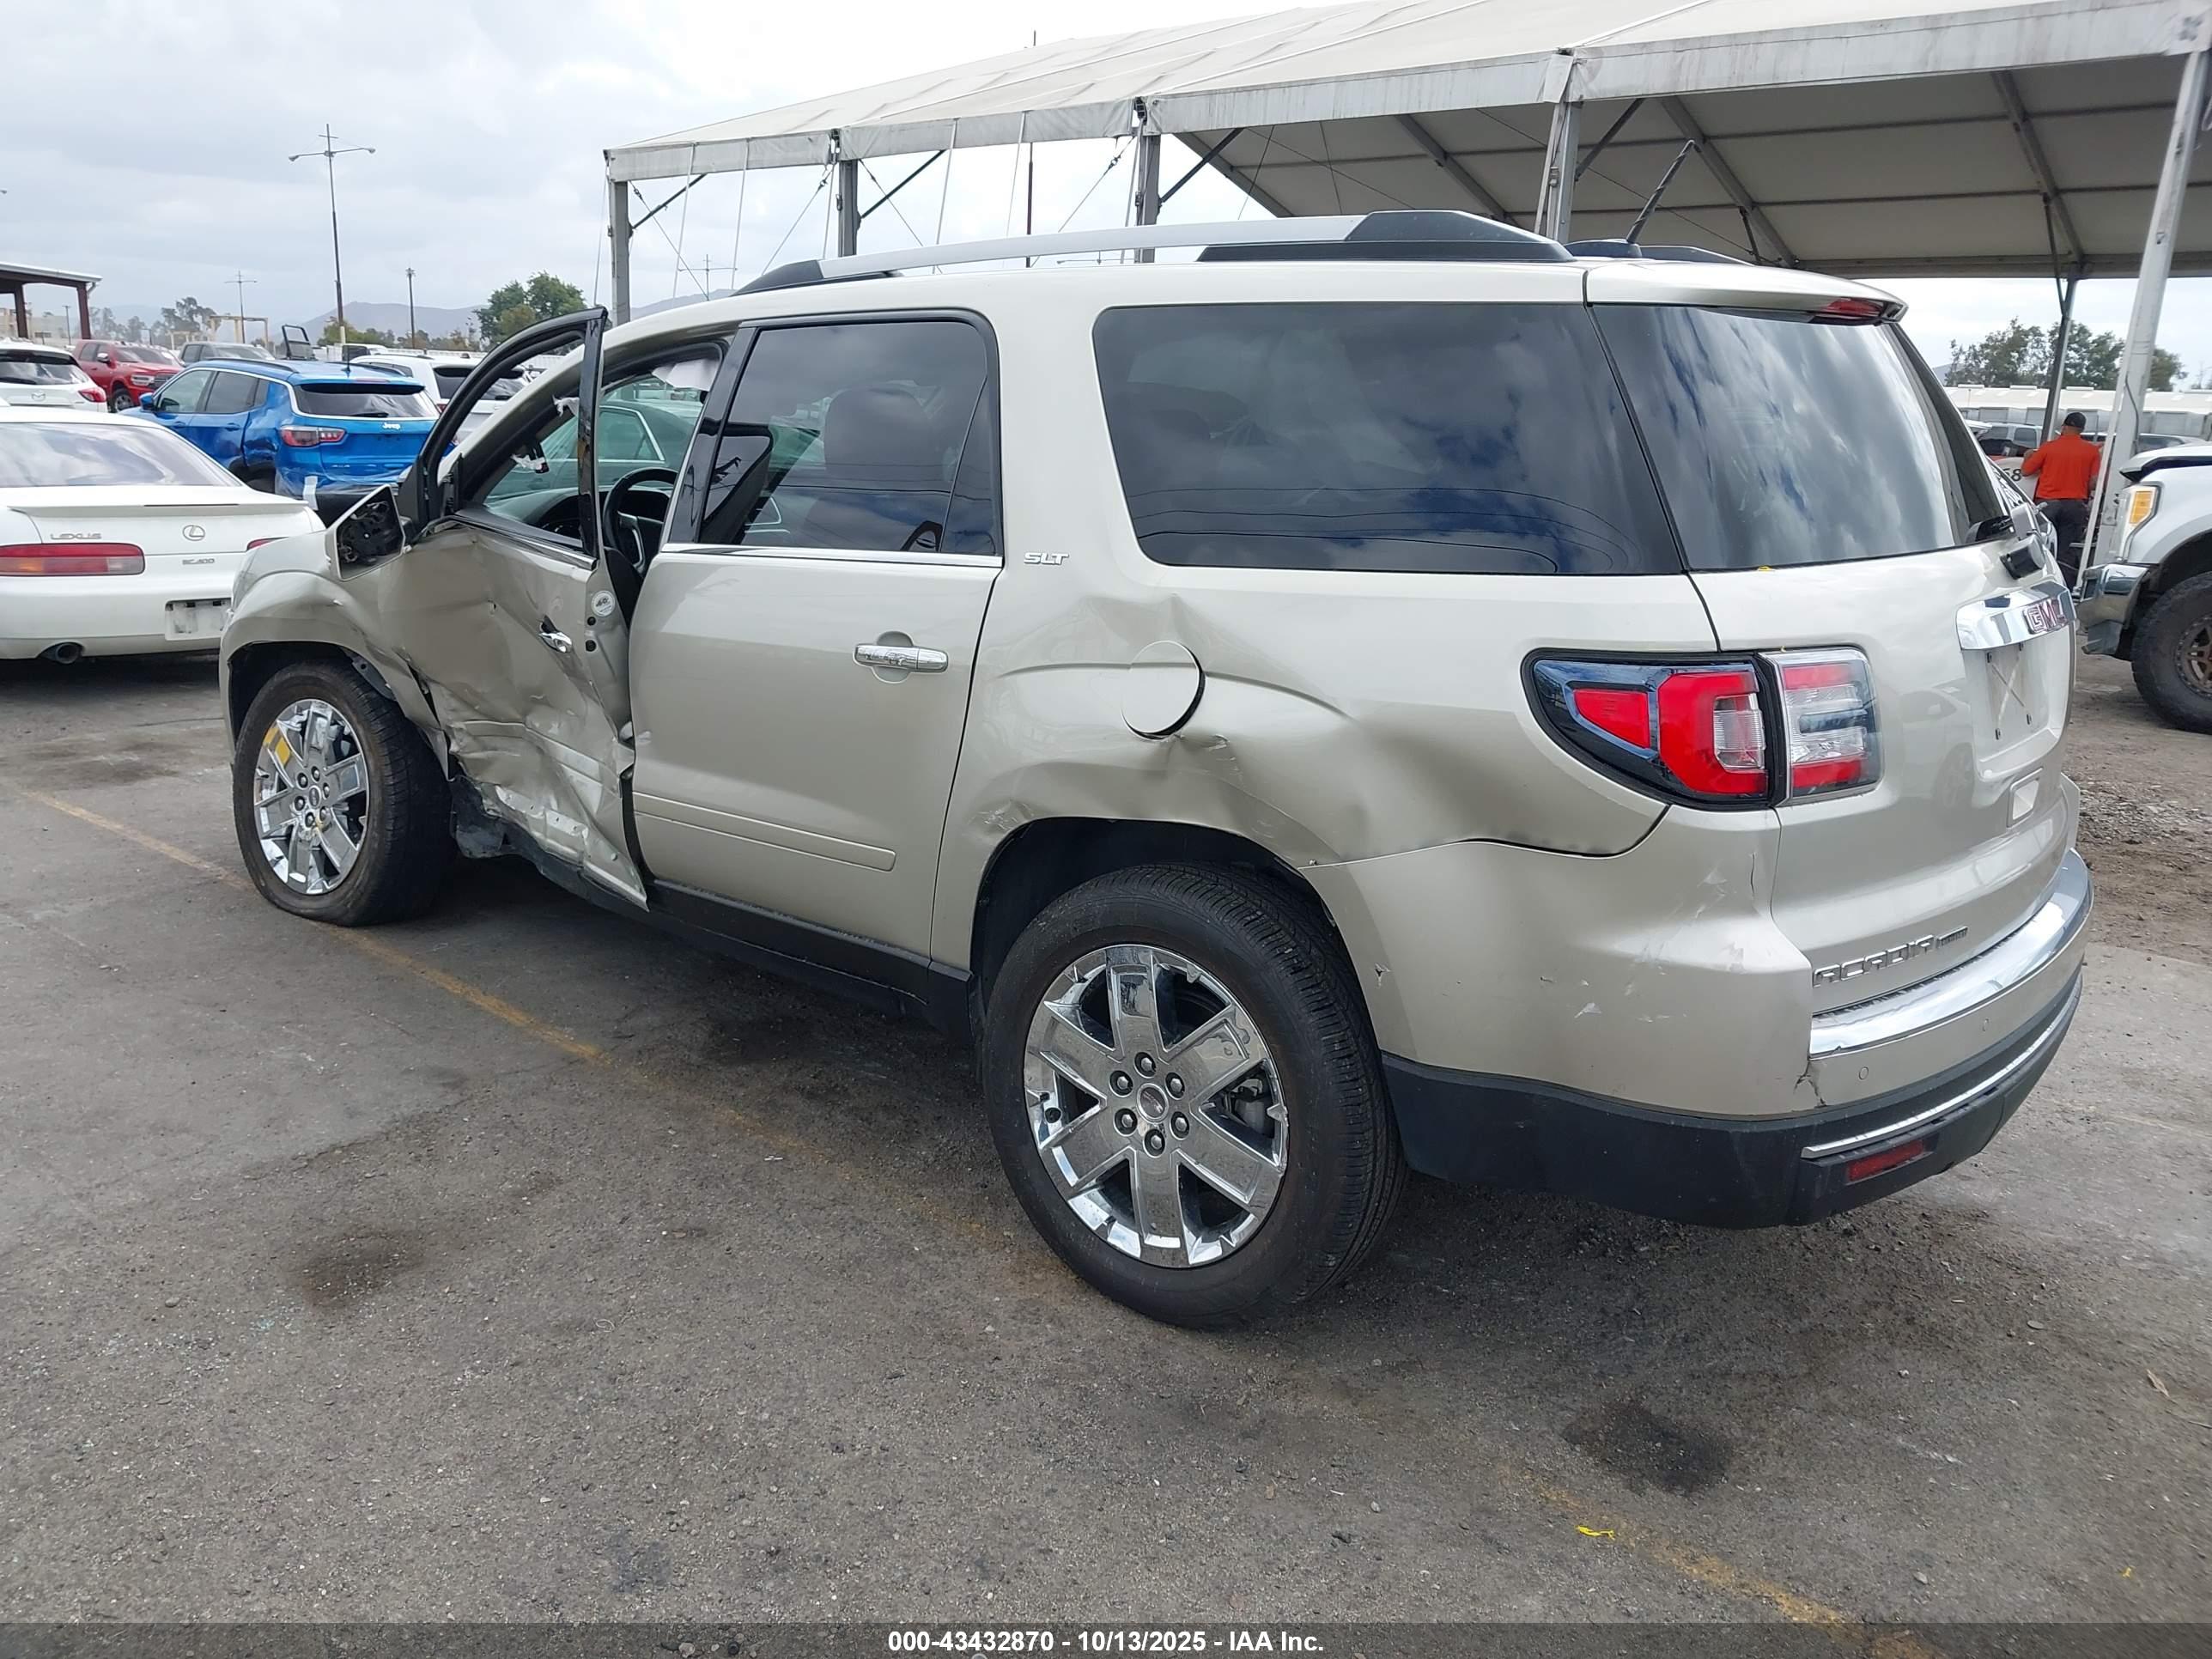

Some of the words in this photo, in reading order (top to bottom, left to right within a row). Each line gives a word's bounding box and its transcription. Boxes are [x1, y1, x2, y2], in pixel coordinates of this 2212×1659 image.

[382, 422, 401, 430] Jeep
[1023, 551, 1069, 566] SLT
[2022, 599, 2067, 634] GMC
[1812, 934, 1934, 988] ACADIA
